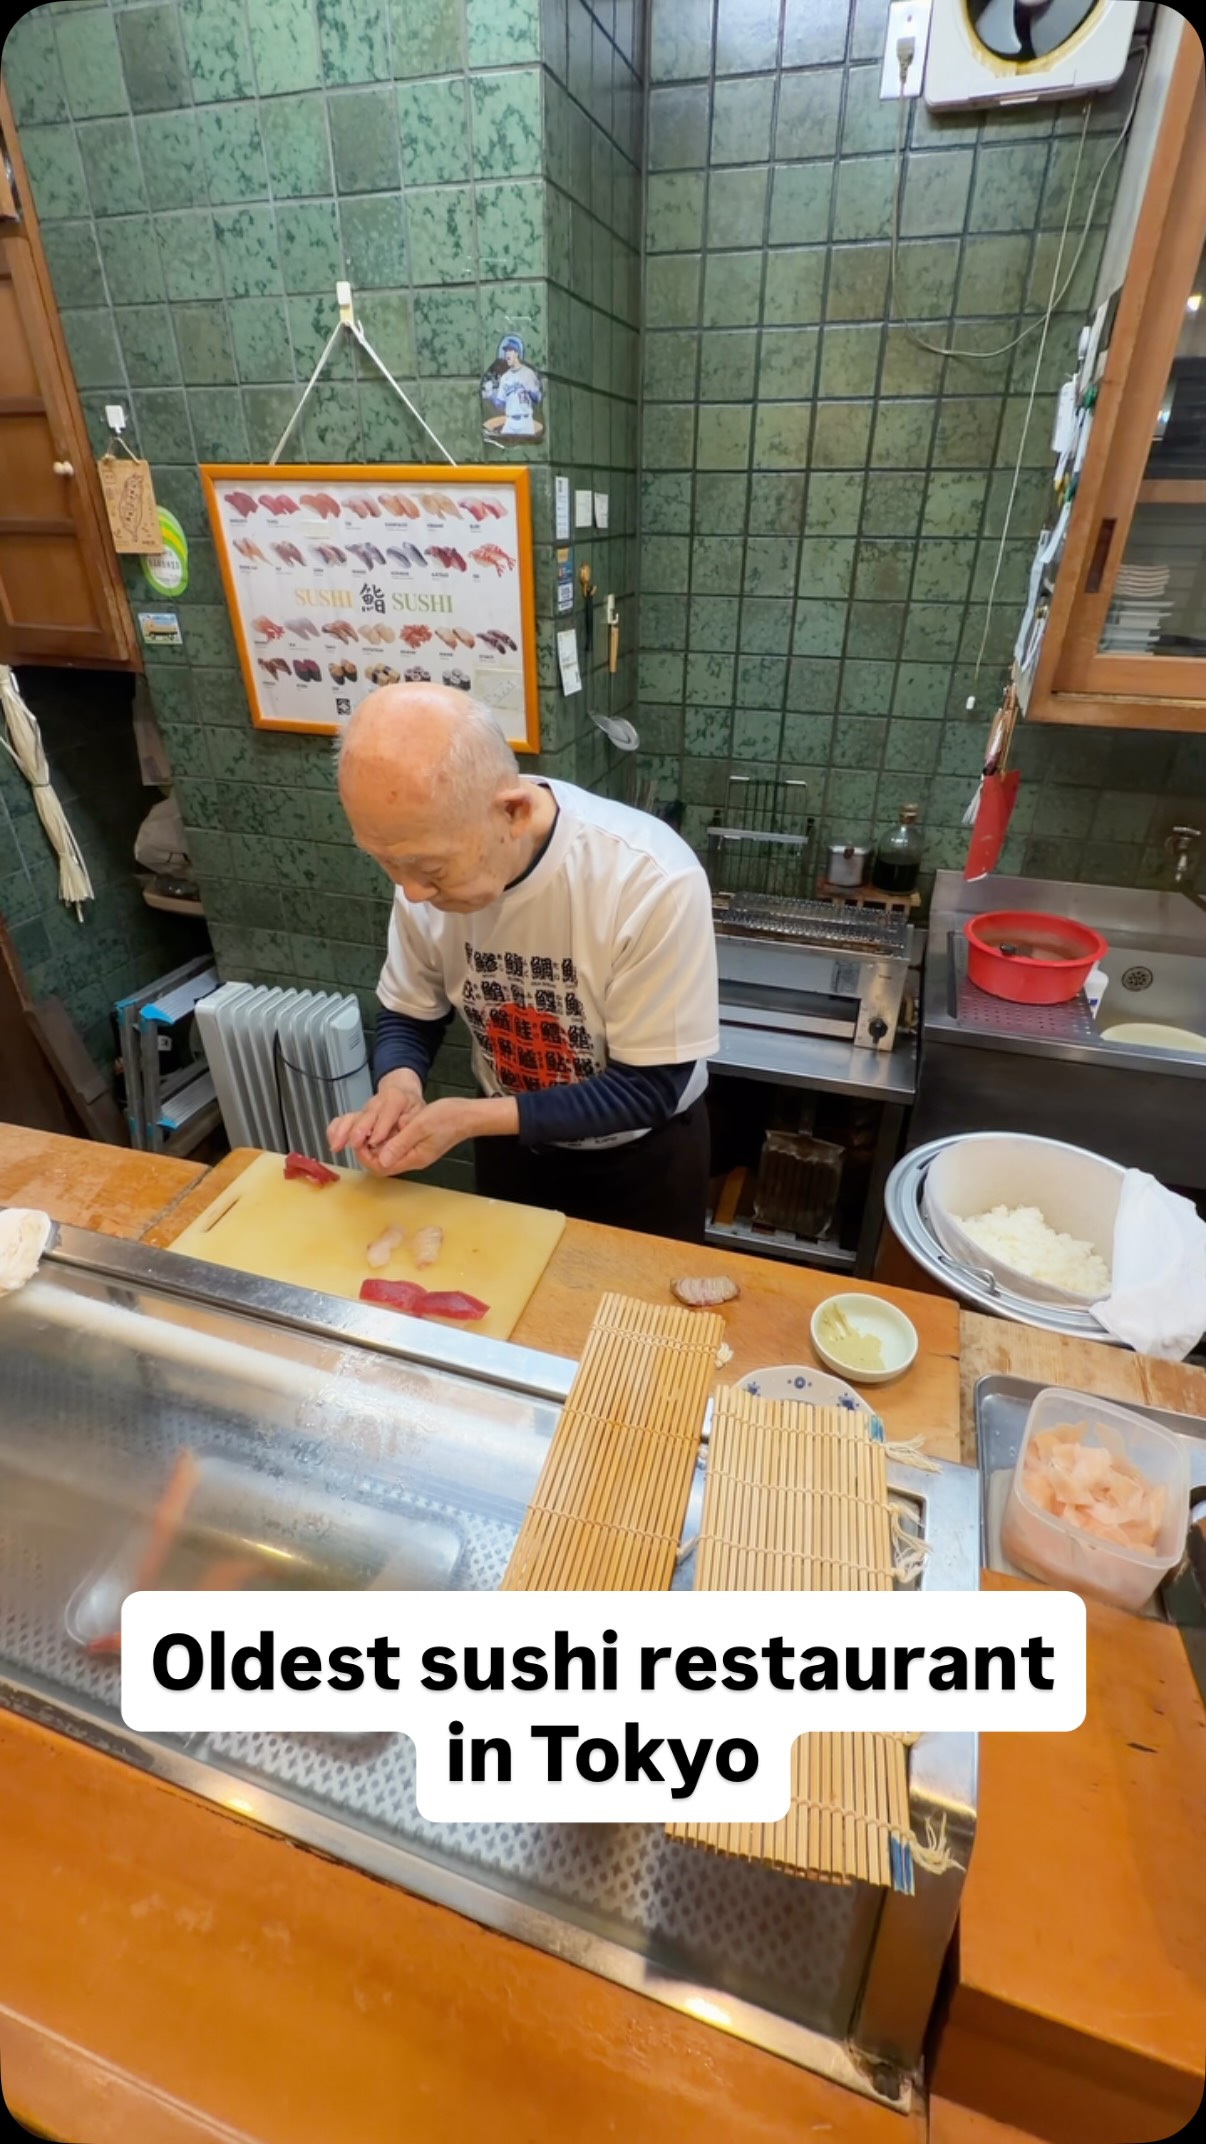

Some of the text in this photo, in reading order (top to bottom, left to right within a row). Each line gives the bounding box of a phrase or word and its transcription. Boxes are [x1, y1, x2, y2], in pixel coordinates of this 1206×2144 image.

[295, 583, 454, 614] SUSHI 鮨 SUSHI
